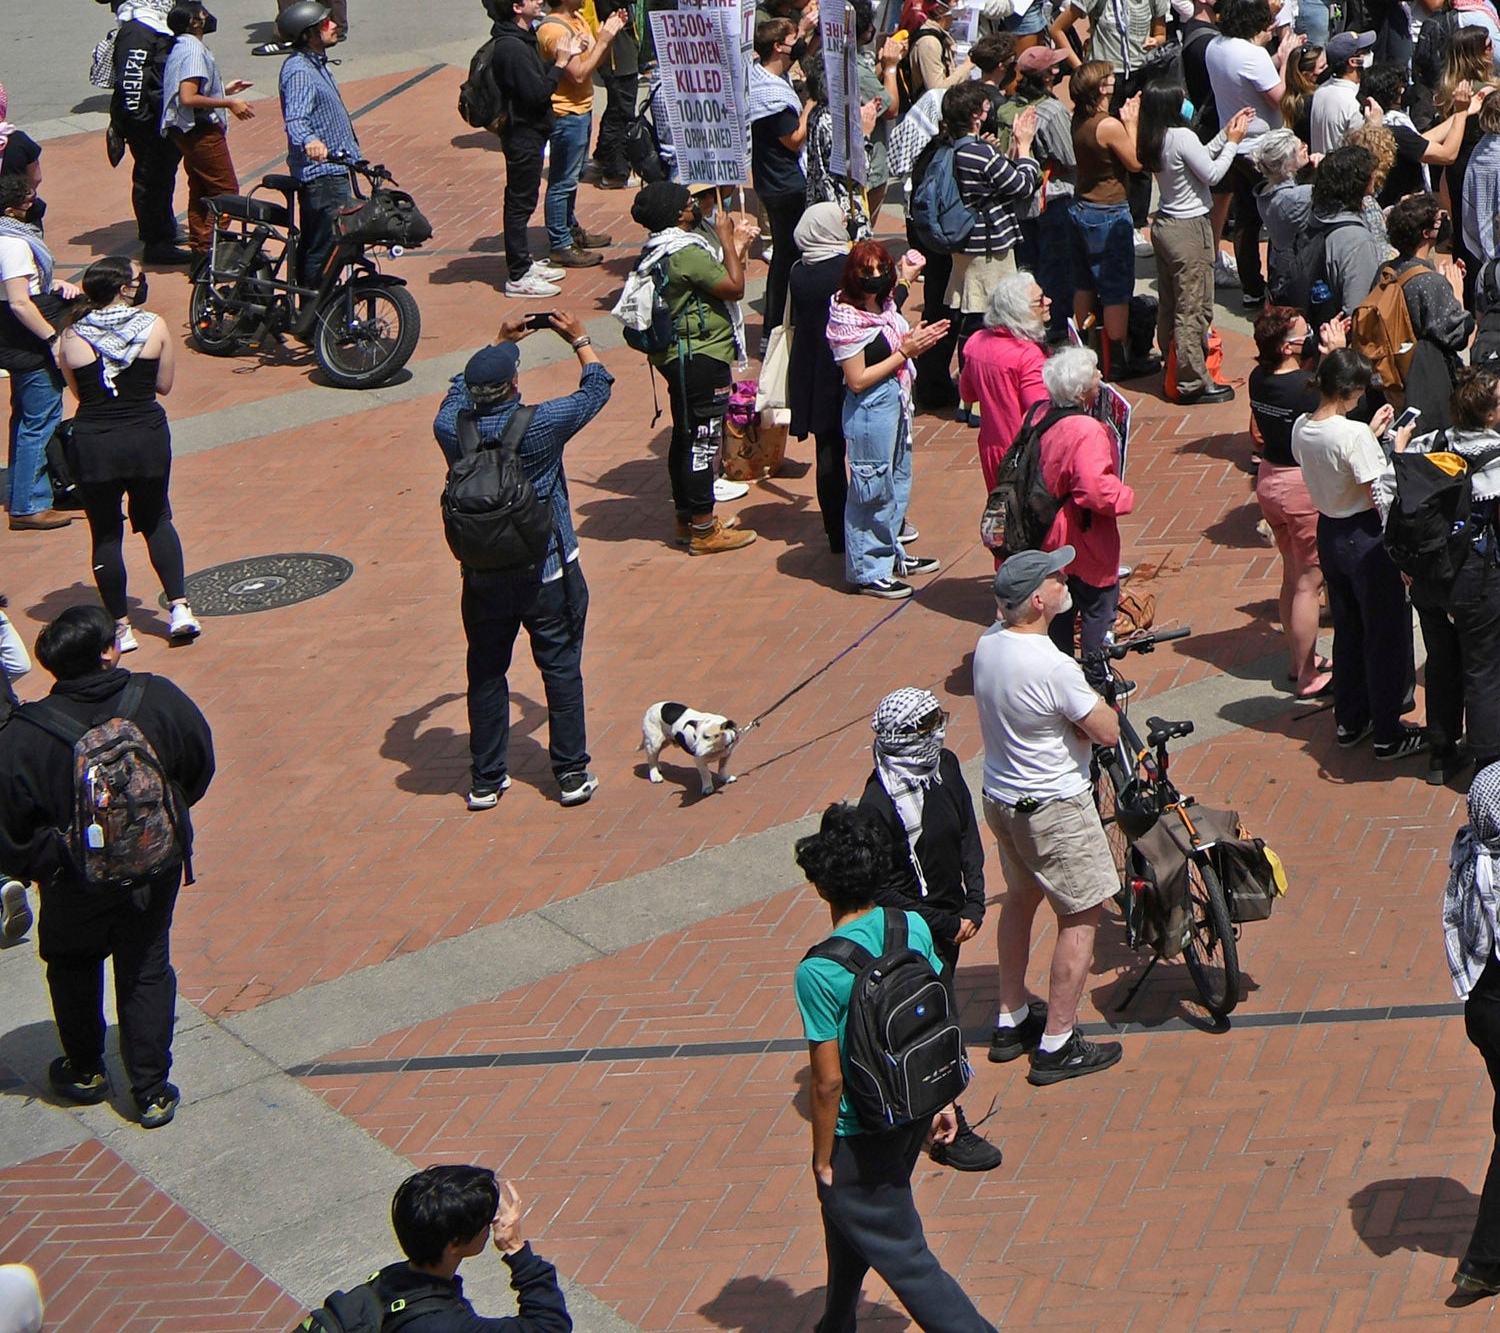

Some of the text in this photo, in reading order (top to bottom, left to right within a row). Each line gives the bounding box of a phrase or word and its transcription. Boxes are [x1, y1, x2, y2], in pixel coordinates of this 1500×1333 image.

[666, 41, 721, 65] CHILDREN
[675, 70, 722, 94] KILLED
[684, 128, 732, 149] ORPHANED
[688, 161, 740, 181] AMPUTATED
